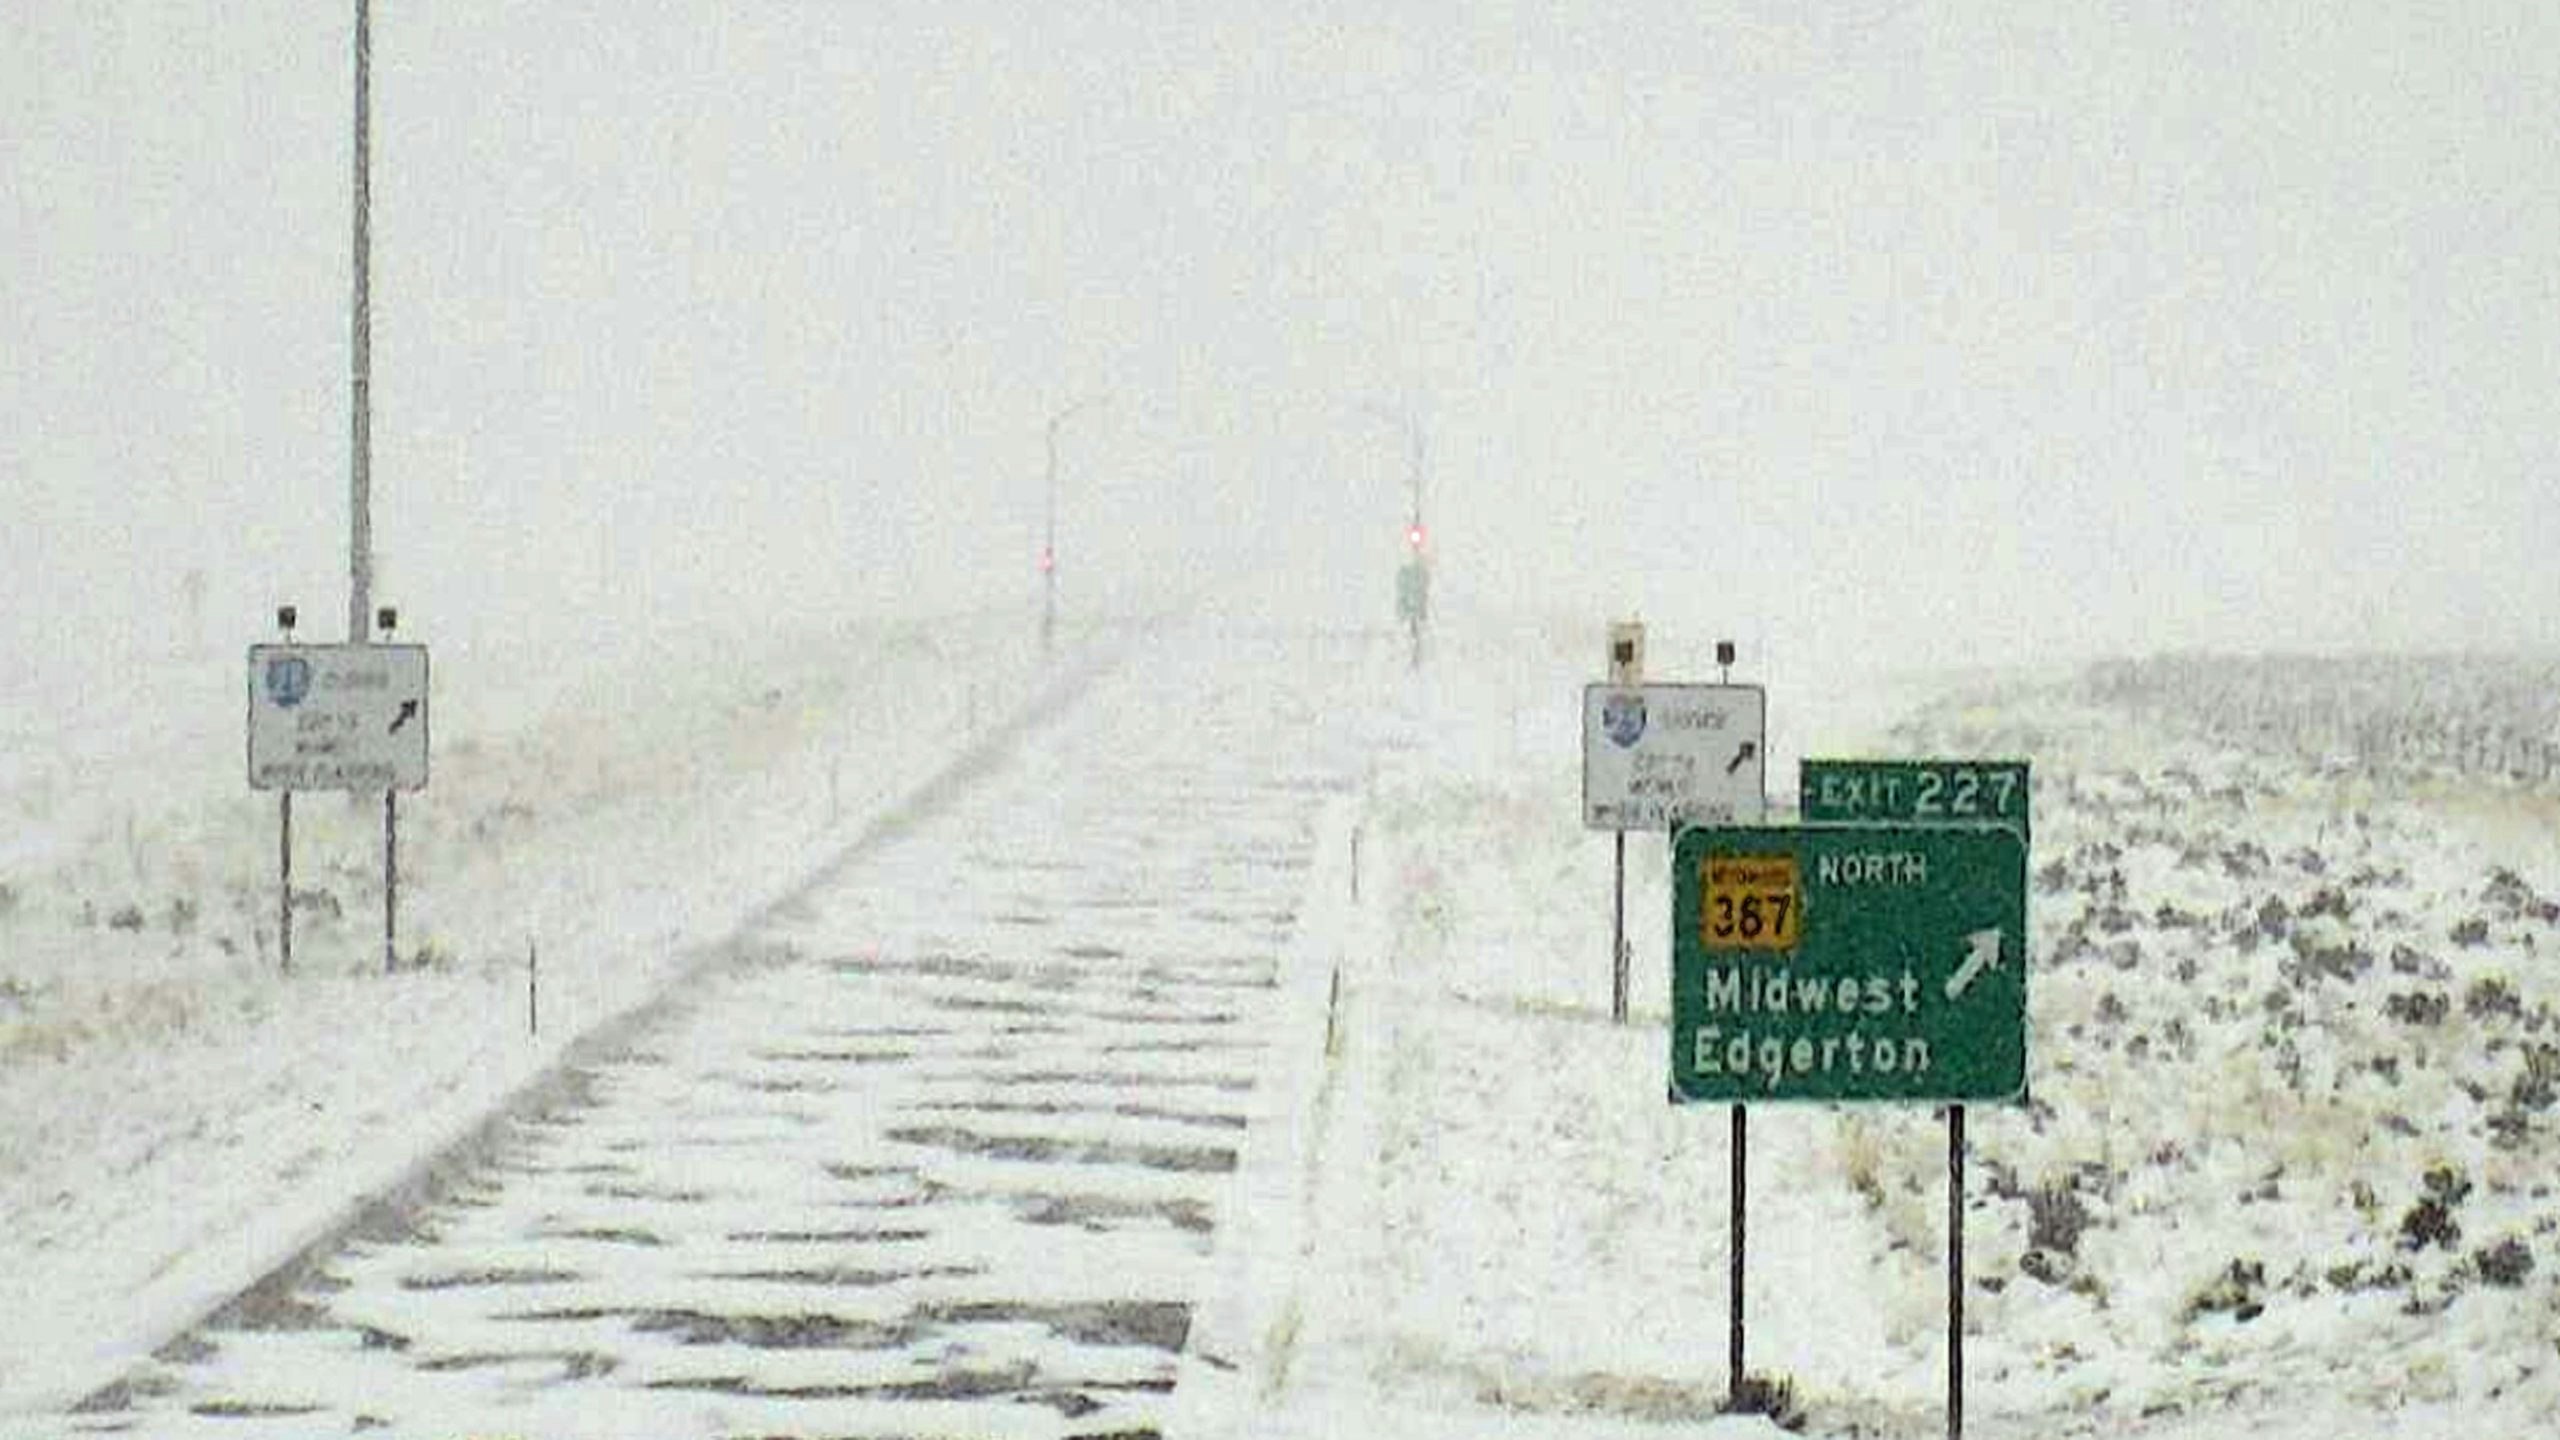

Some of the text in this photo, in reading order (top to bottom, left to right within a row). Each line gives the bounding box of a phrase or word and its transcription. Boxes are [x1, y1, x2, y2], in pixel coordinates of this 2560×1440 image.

[1821, 770, 2017, 814] EXIT 227
[1818, 852, 1927, 886] NORTH
[1706, 968, 1919, 1013] Midwest
[1693, 1026, 1931, 1089] Edgerton
